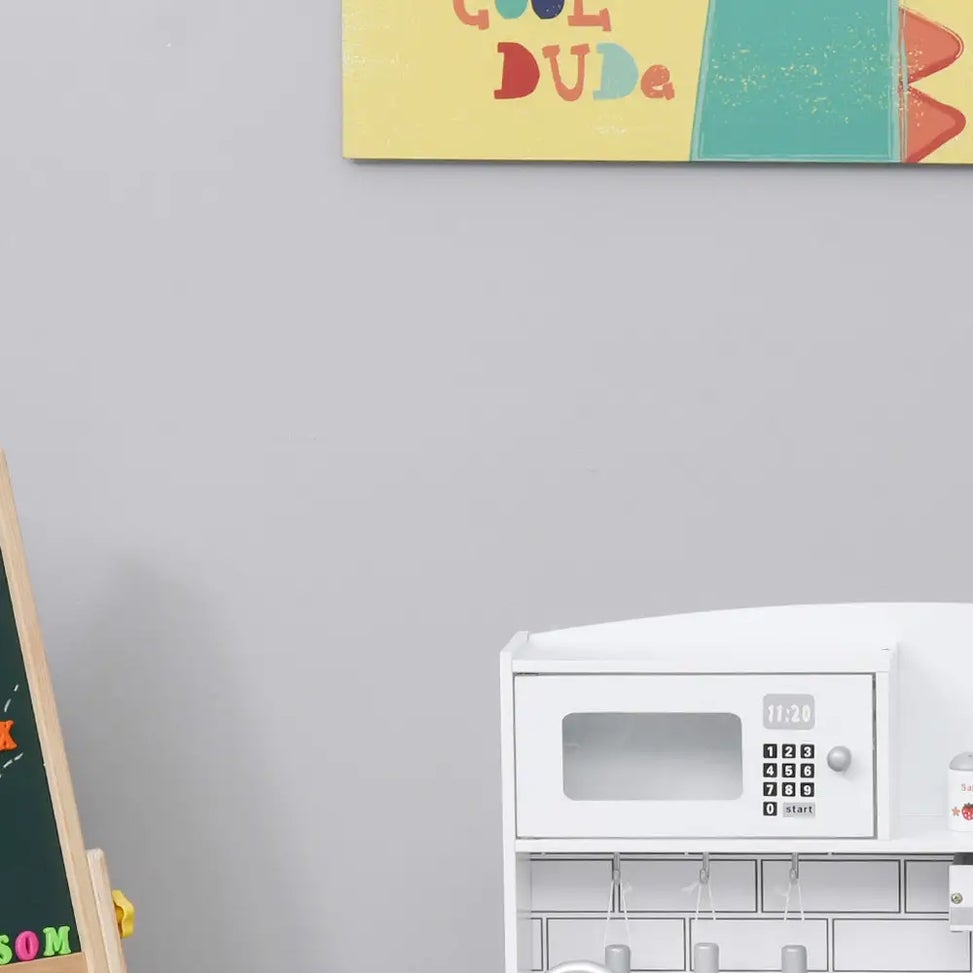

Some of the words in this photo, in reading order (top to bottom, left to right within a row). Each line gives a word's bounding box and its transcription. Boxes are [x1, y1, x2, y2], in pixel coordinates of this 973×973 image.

[767, 704, 811, 723] 11:20
[767, 746, 774, 758] 1
[784, 746, 793, 758] 2
[803, 746, 812, 758] 3
[766, 765, 775, 776] 4
[784, 765, 793, 777] 5
[803, 765, 812, 777] 6
[766, 784, 774, 796] 7
[784, 784, 793, 796] 8
[803, 784, 812, 796] 9
[766, 803, 775, 815] 0
[785, 804, 813, 814] start
